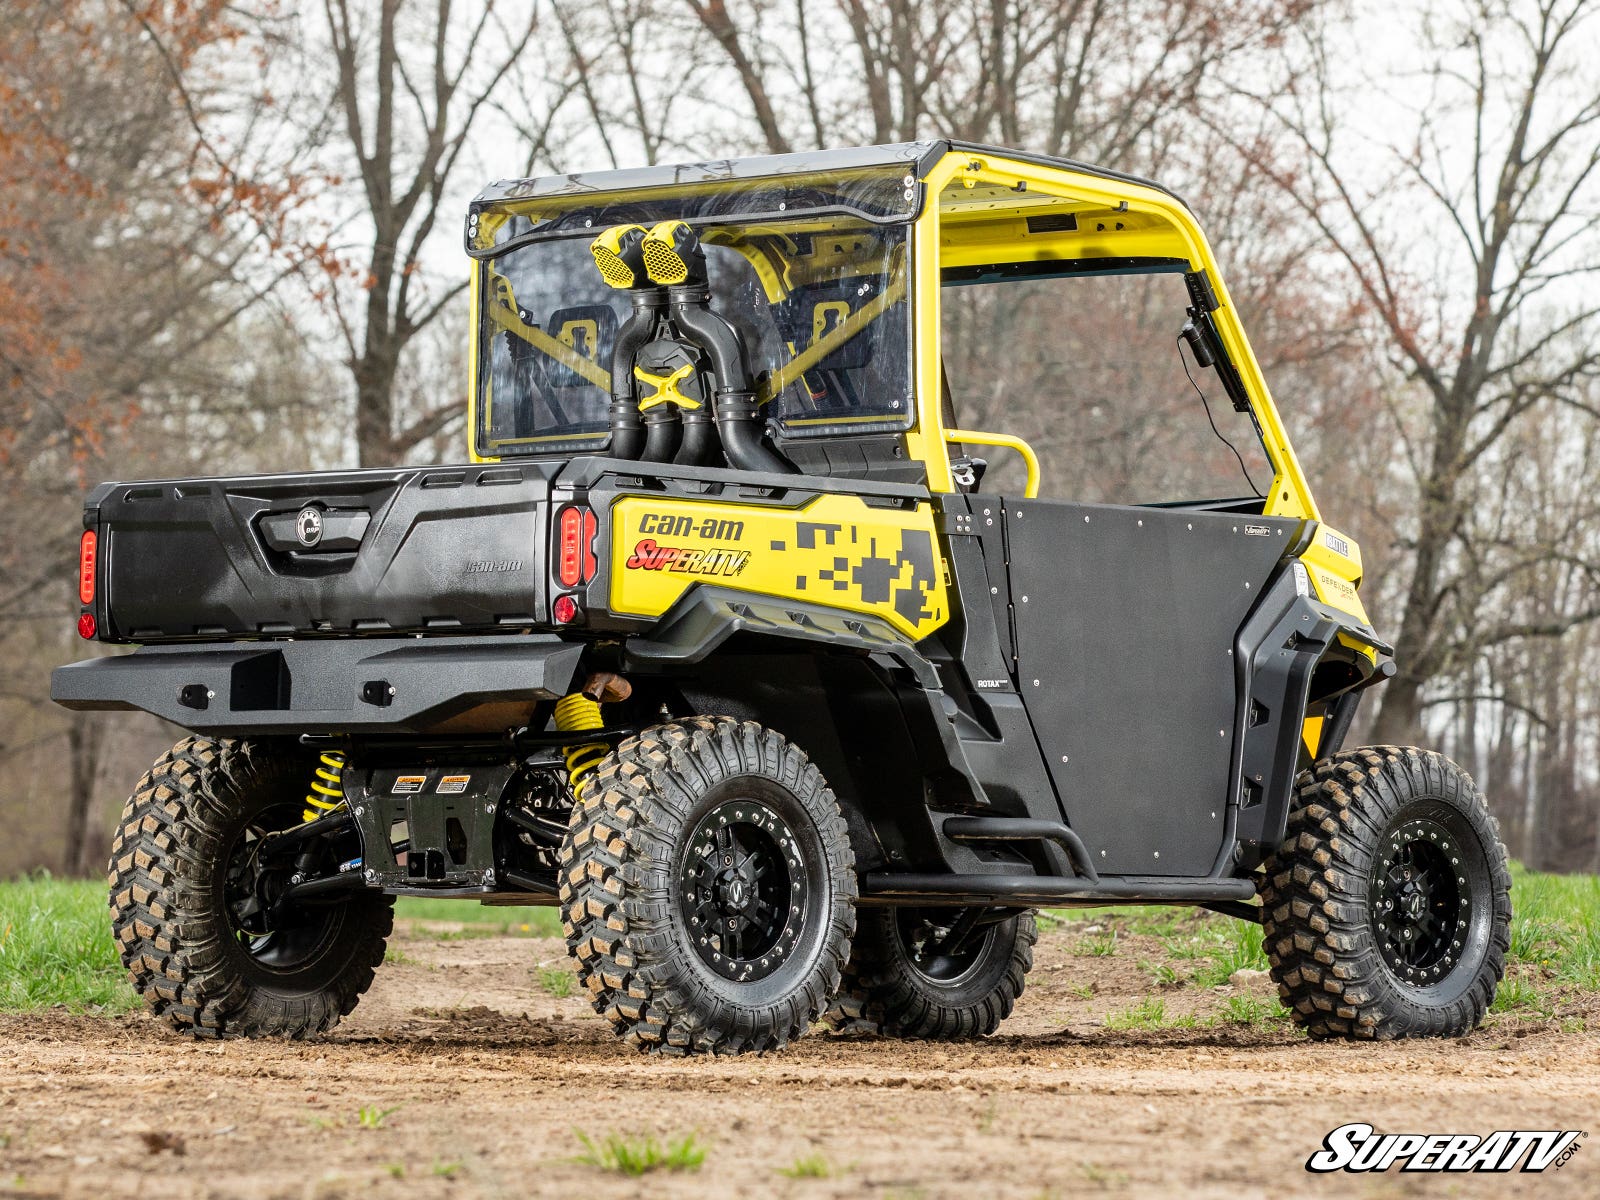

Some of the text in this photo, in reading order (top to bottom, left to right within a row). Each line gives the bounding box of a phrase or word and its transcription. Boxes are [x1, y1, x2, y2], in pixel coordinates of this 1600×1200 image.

[639, 513, 744, 541] can-am
[467, 560, 523, 573] can-am
[1321, 575, 1354, 595] DEFENDER
[978, 679, 1000, 688] ROTAX
